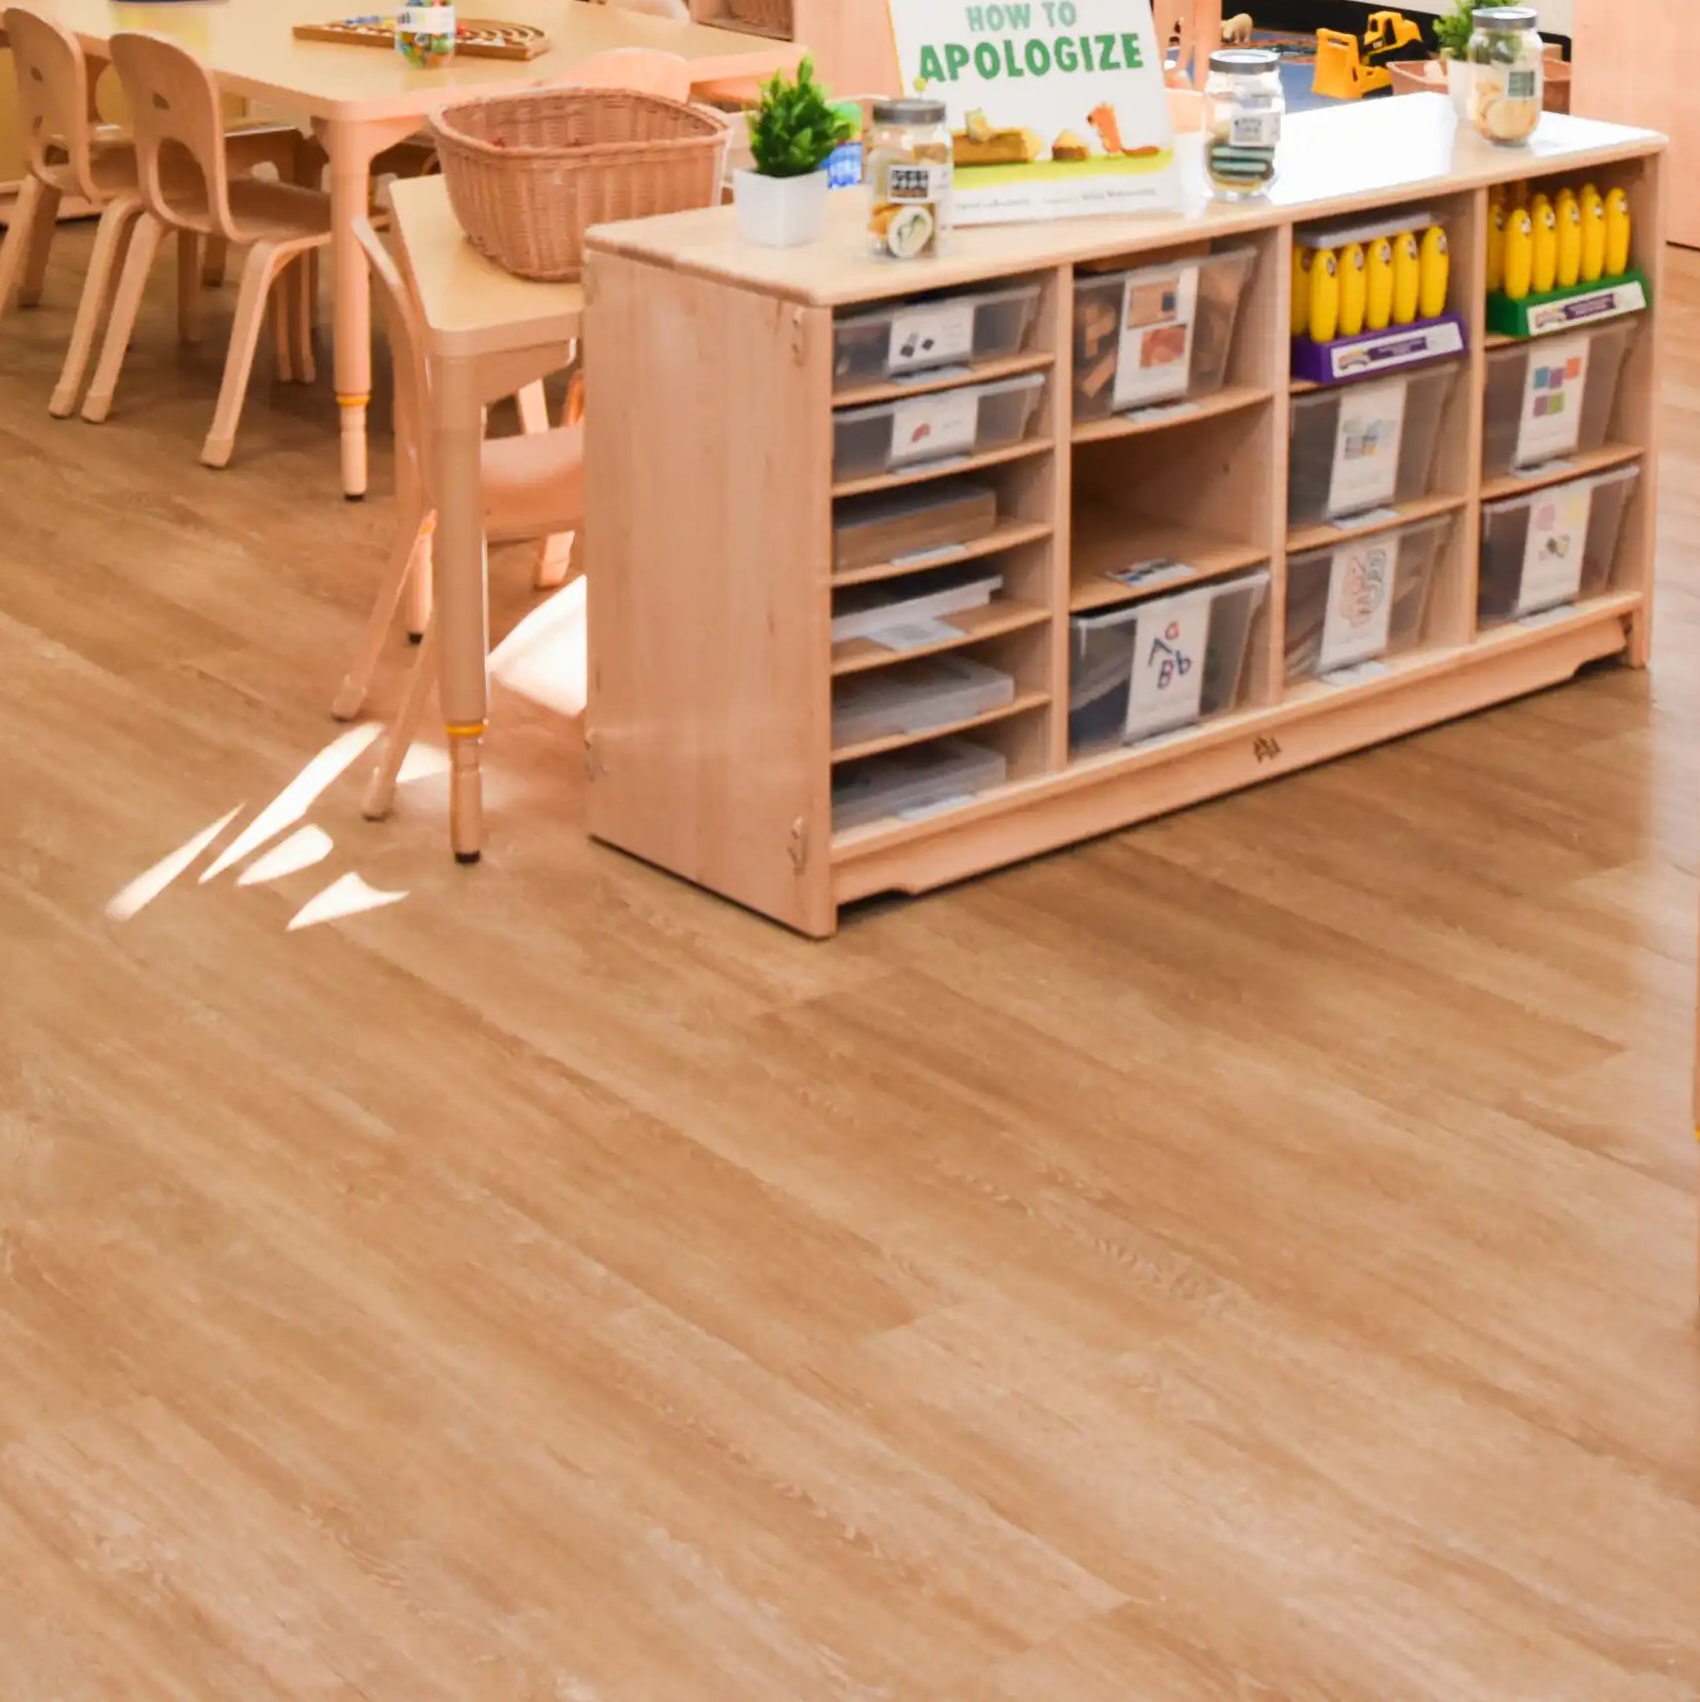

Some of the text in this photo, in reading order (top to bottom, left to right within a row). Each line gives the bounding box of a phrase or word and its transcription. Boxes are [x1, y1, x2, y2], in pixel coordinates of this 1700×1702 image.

[965, 1, 1077, 32] HOW TO
[919, 33, 1144, 82] APOLOGIZE
